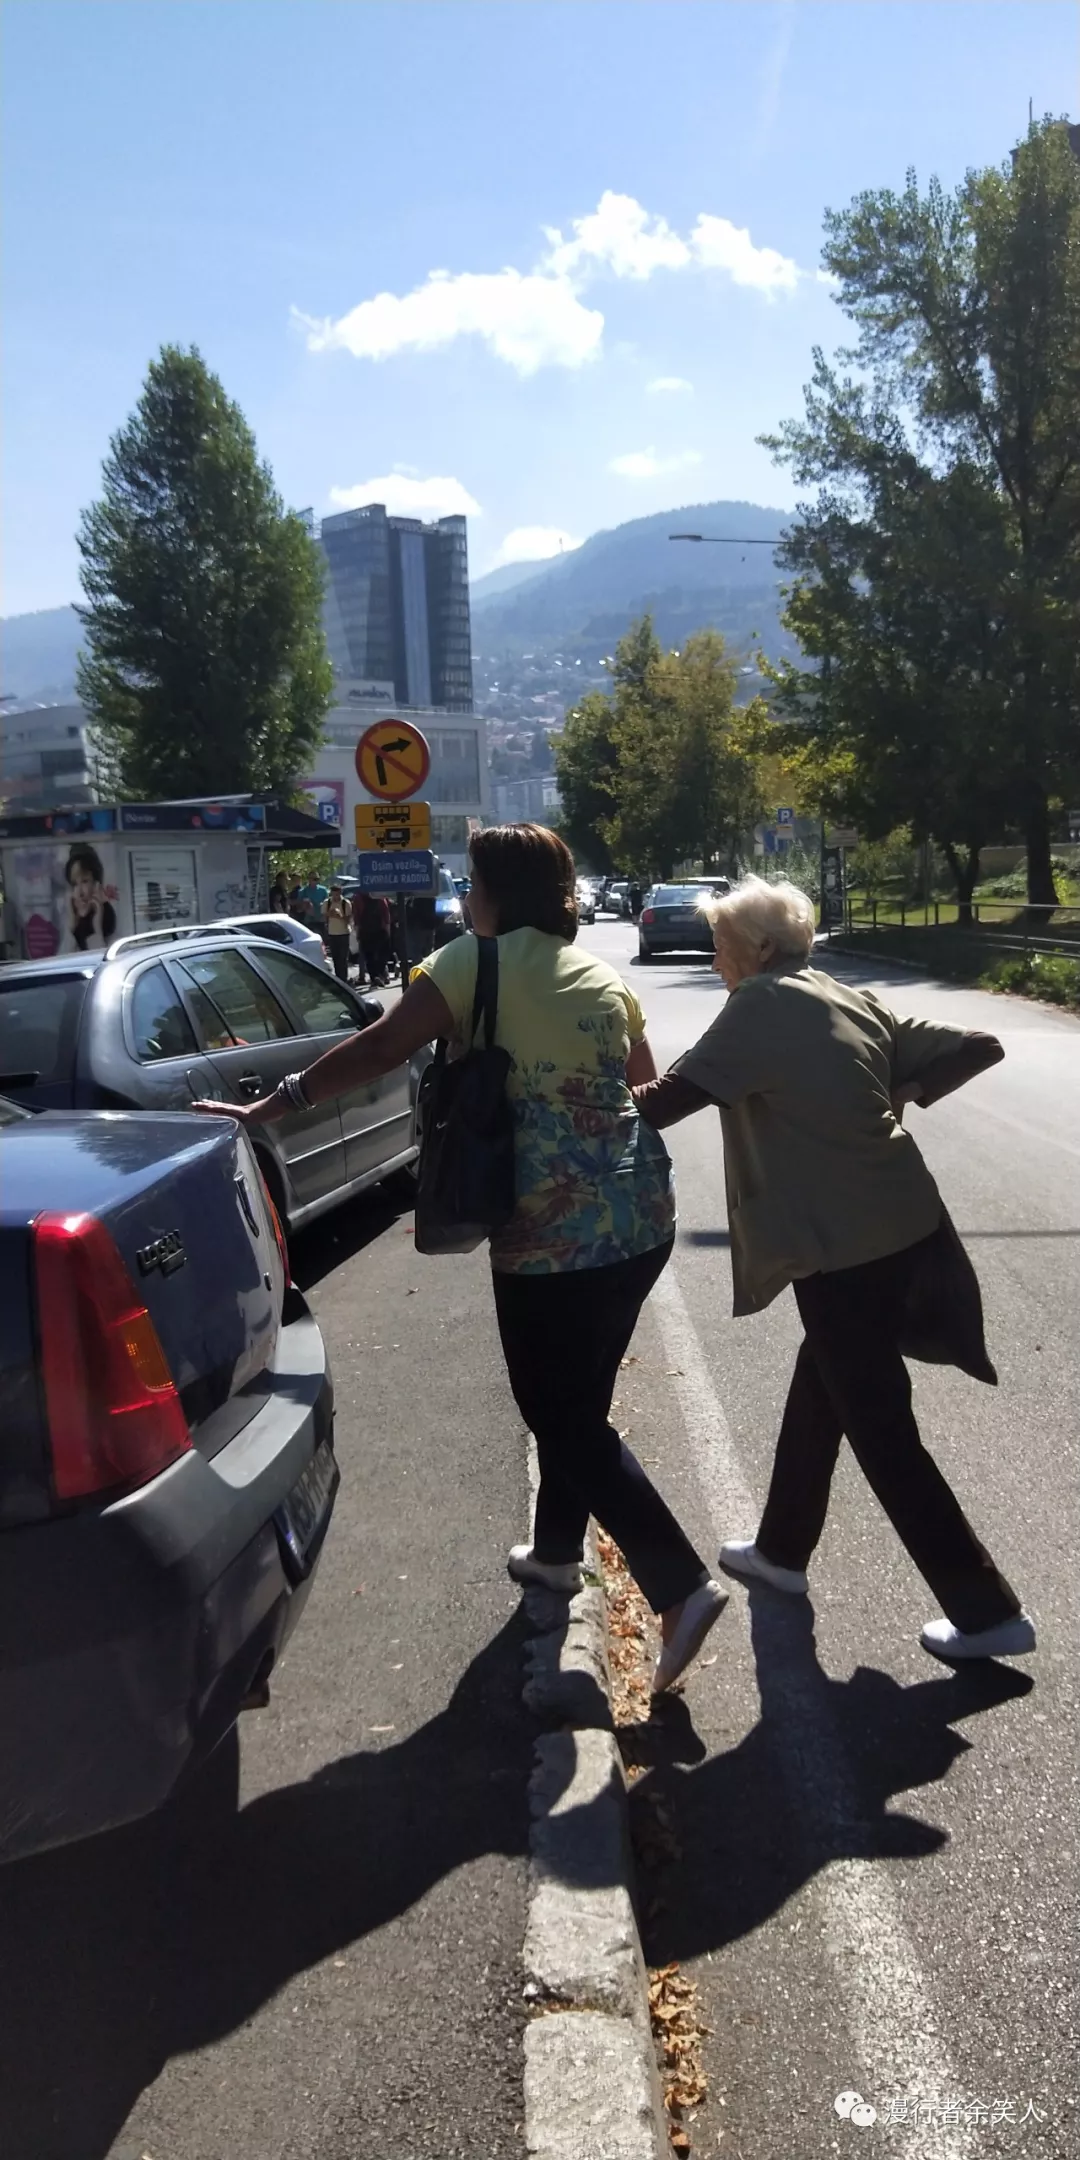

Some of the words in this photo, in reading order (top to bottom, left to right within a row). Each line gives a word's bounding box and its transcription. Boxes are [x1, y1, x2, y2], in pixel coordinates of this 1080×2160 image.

[323, 804, 335, 820] P
[780, 810, 791, 822] P
[371, 860, 393, 872] Osim
[136, 1228, 184, 1272] LOGAN
